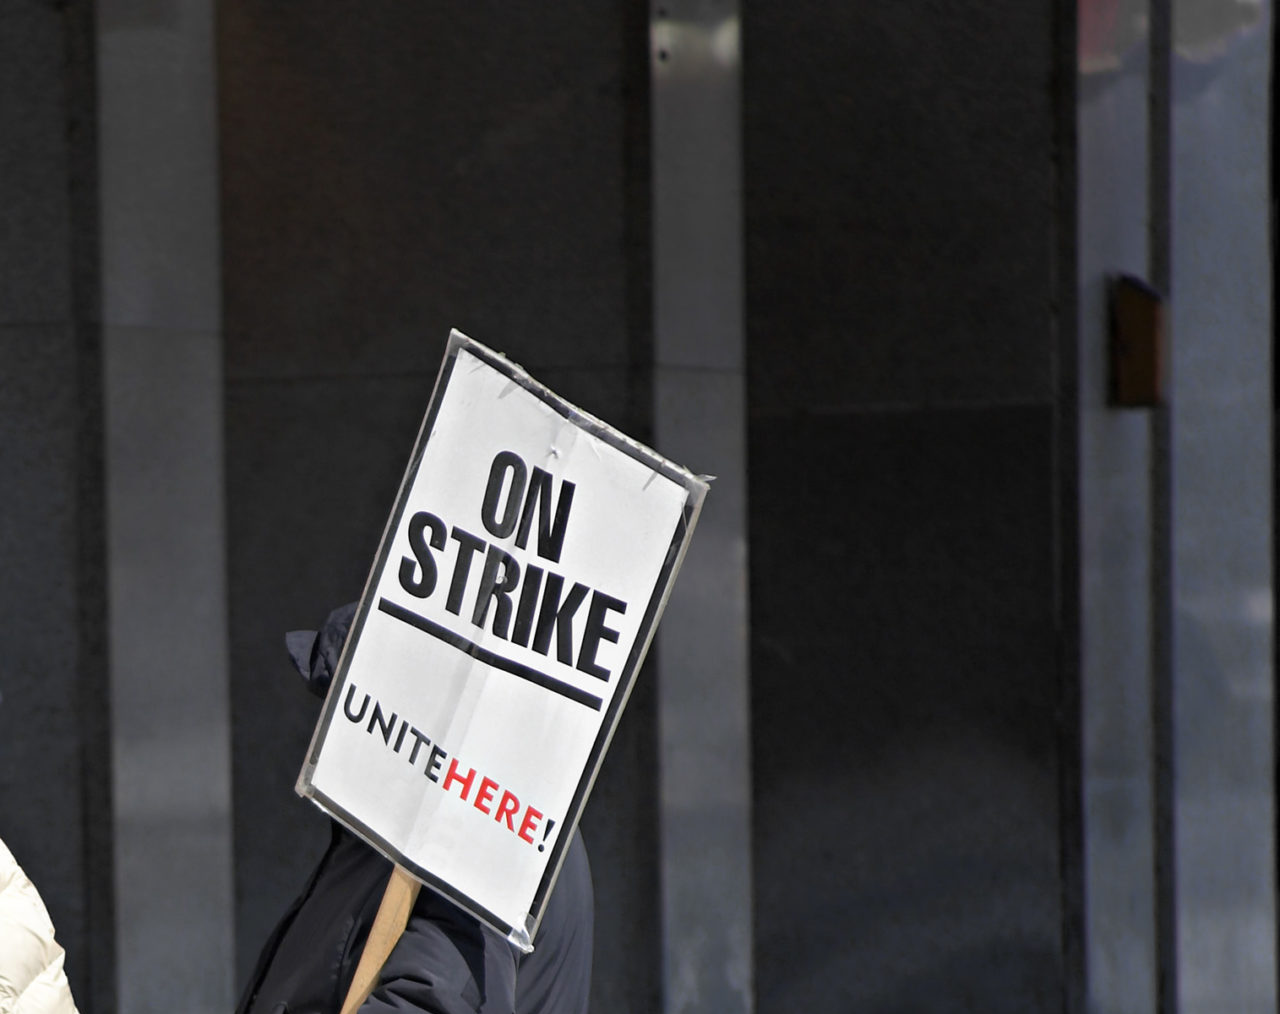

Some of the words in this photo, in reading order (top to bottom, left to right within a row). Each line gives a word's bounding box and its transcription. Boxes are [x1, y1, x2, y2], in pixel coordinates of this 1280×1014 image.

[481, 450, 576, 564] ON
[398, 511, 627, 682] STRIKE
[343, 683, 555, 853] UNITEHERE!
